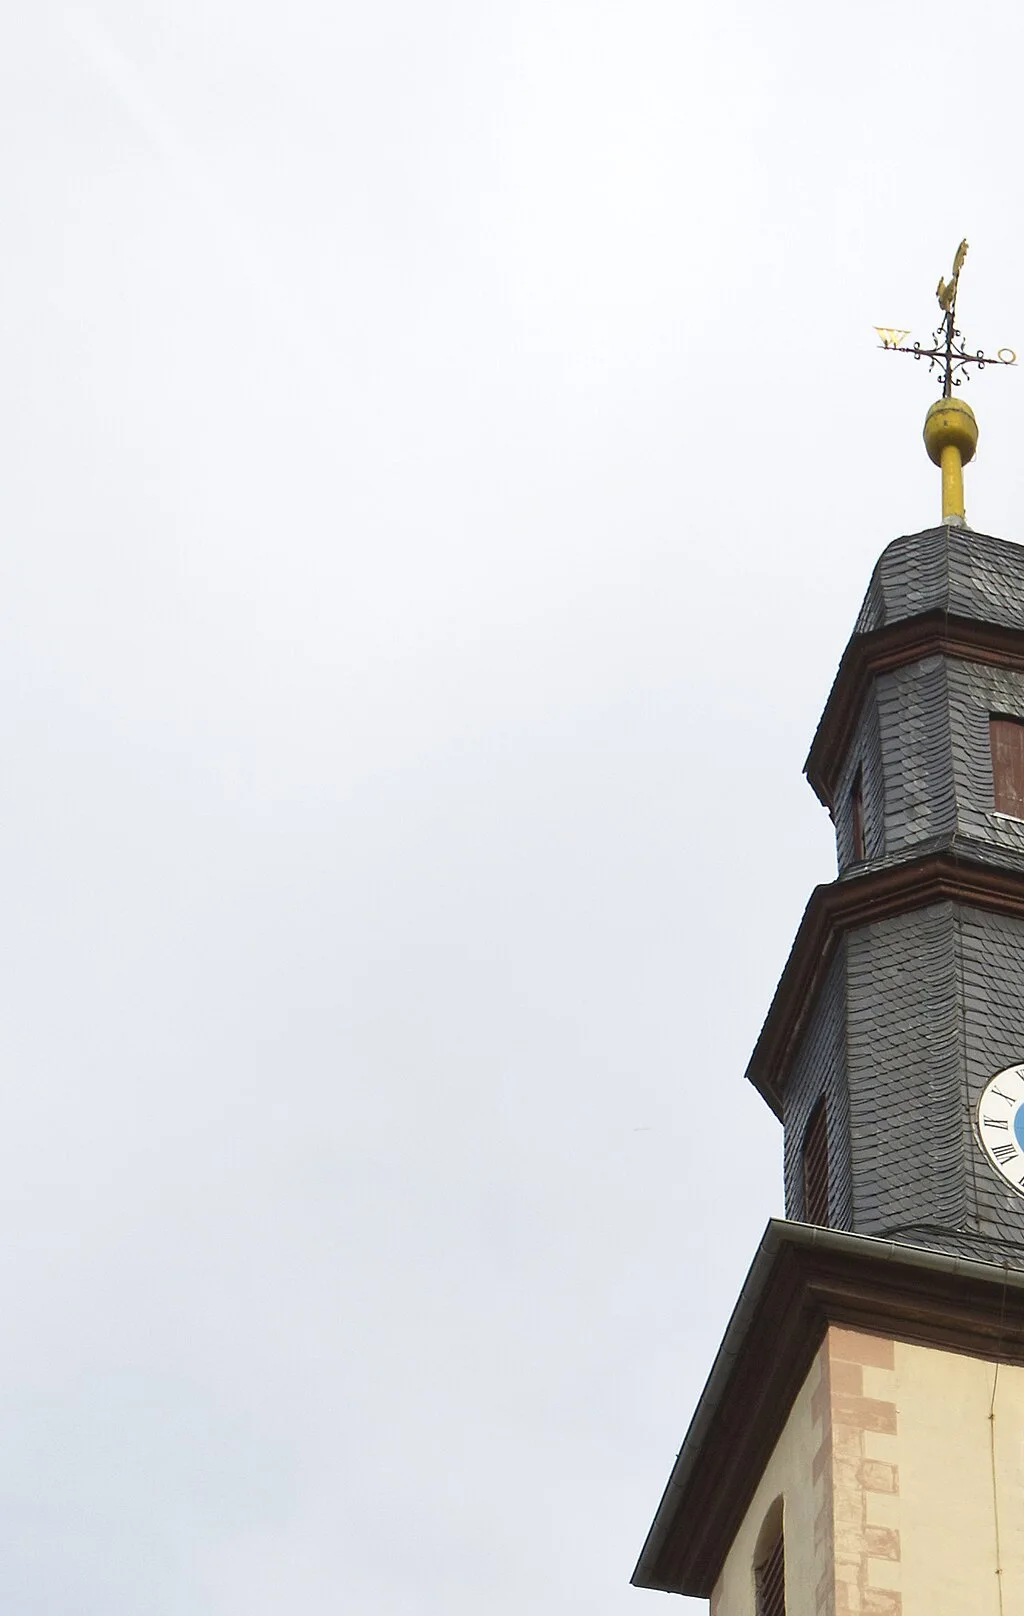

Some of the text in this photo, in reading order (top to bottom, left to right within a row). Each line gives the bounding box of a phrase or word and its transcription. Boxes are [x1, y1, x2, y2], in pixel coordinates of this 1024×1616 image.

[991, 1085, 1016, 1107] X
[983, 1114, 1009, 1131] IX
[991, 1143, 1019, 1165] VIII
